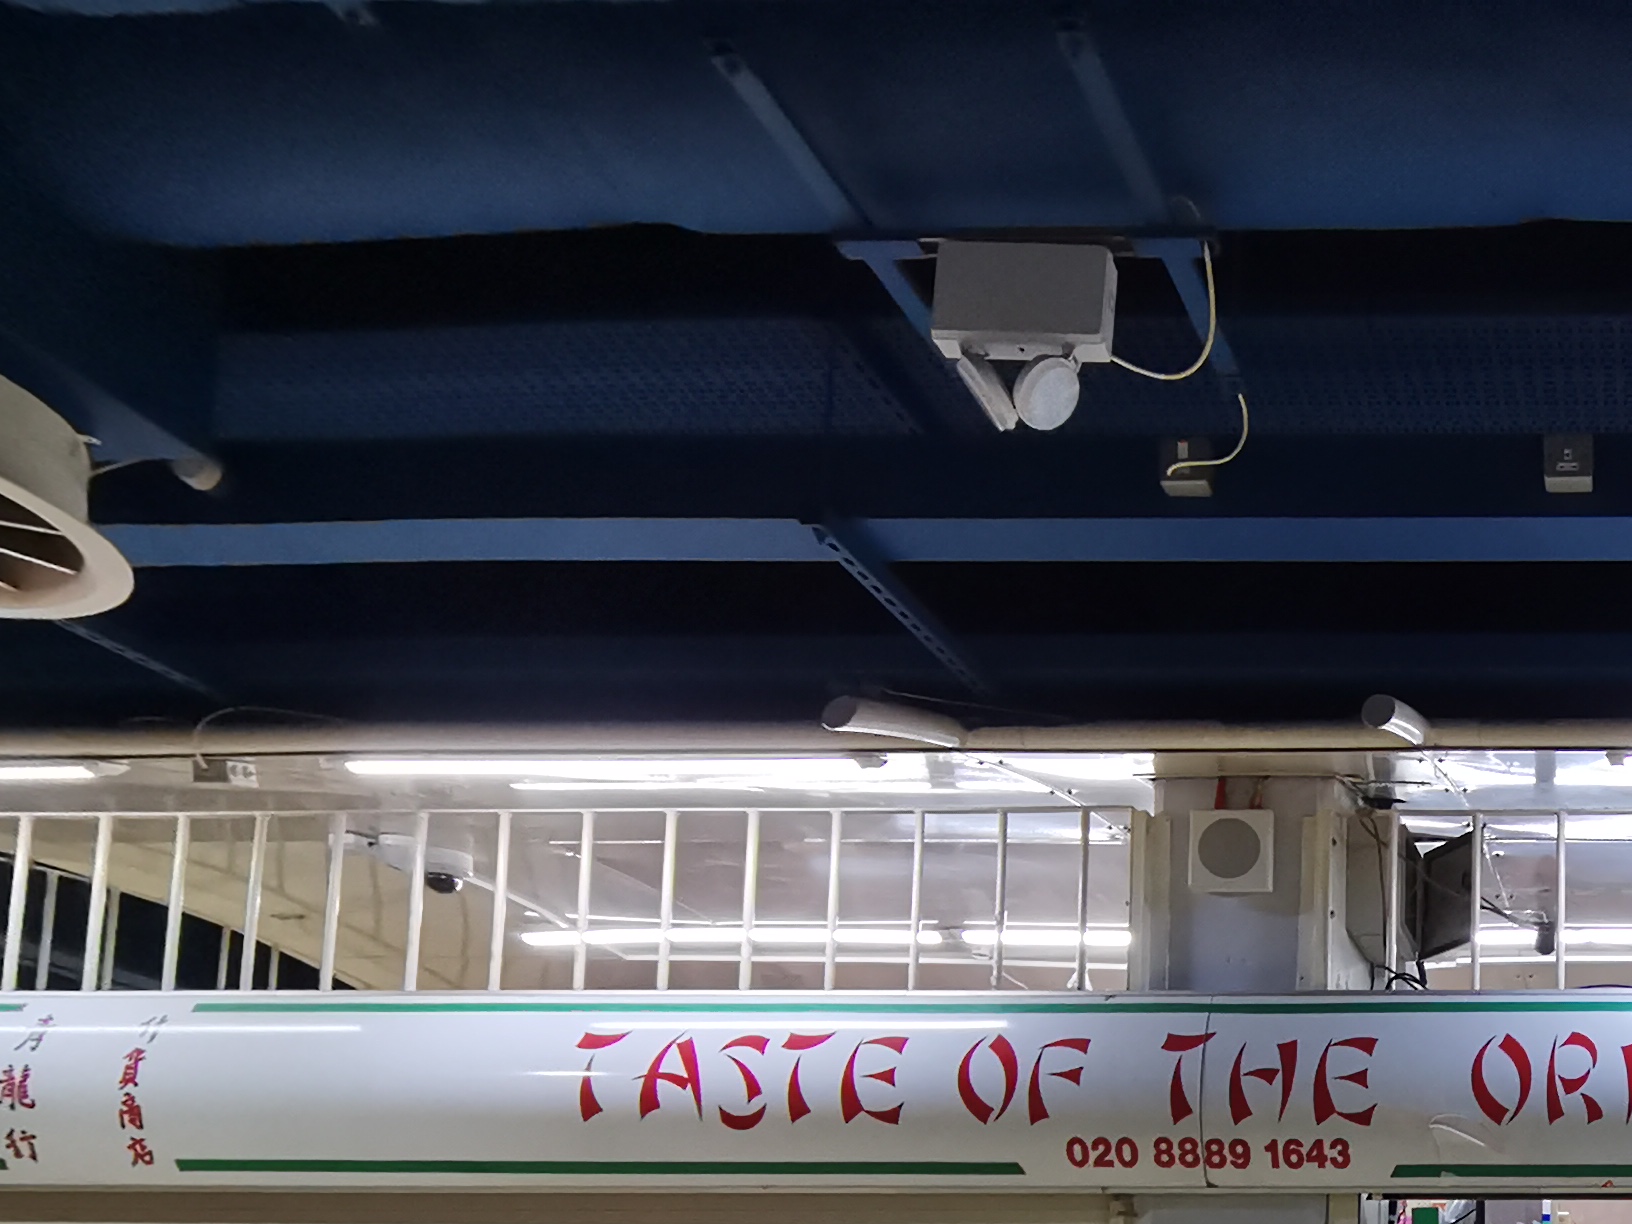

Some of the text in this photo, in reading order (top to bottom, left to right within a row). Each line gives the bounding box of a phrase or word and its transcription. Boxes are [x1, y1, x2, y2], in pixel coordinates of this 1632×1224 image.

[576, 1031, 910, 1131] TASTE
[957, 1033, 1091, 1126] OF
[1161, 1031, 1379, 1126] THE
[1066, 1137, 1352, 1170] 020 8889 1643
